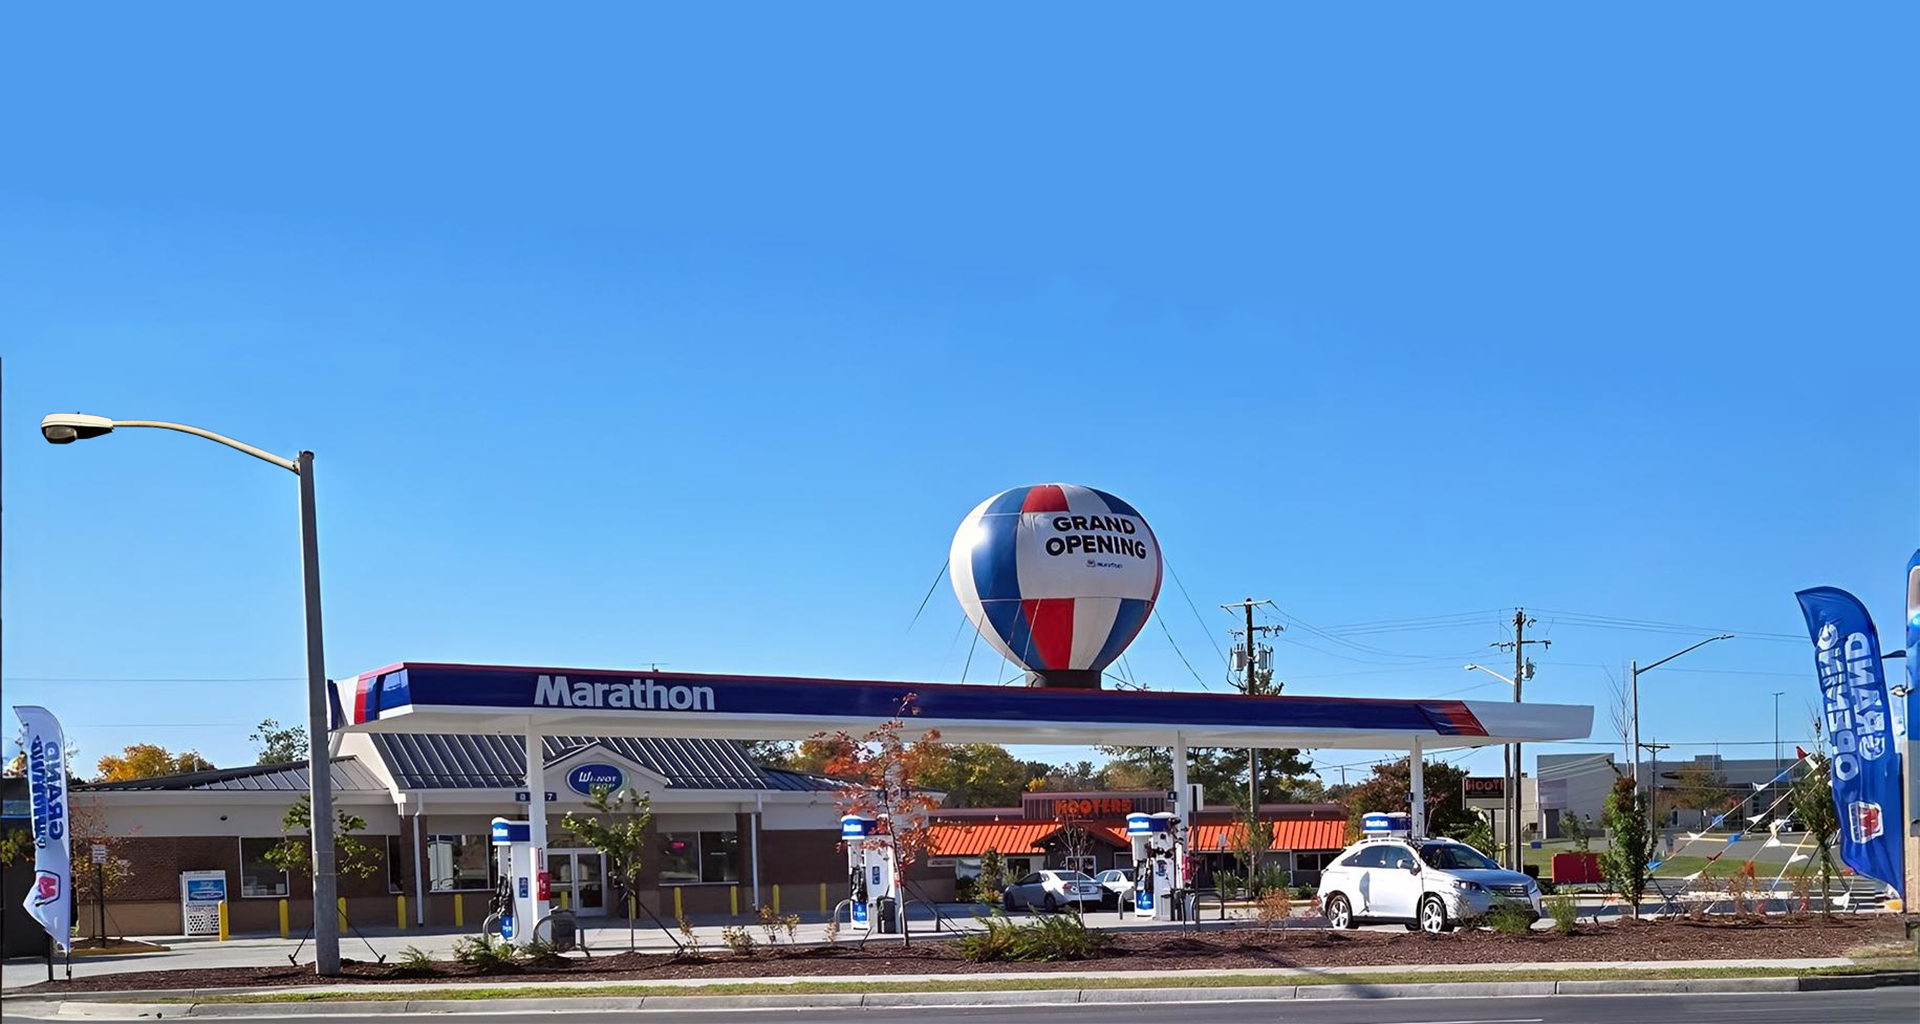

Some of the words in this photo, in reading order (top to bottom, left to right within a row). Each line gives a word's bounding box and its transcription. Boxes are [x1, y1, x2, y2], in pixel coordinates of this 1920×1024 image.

[1052, 515, 1136, 535] GRAND
[1045, 535, 1147, 559] OPENING
[534, 674, 716, 711] Marathon
